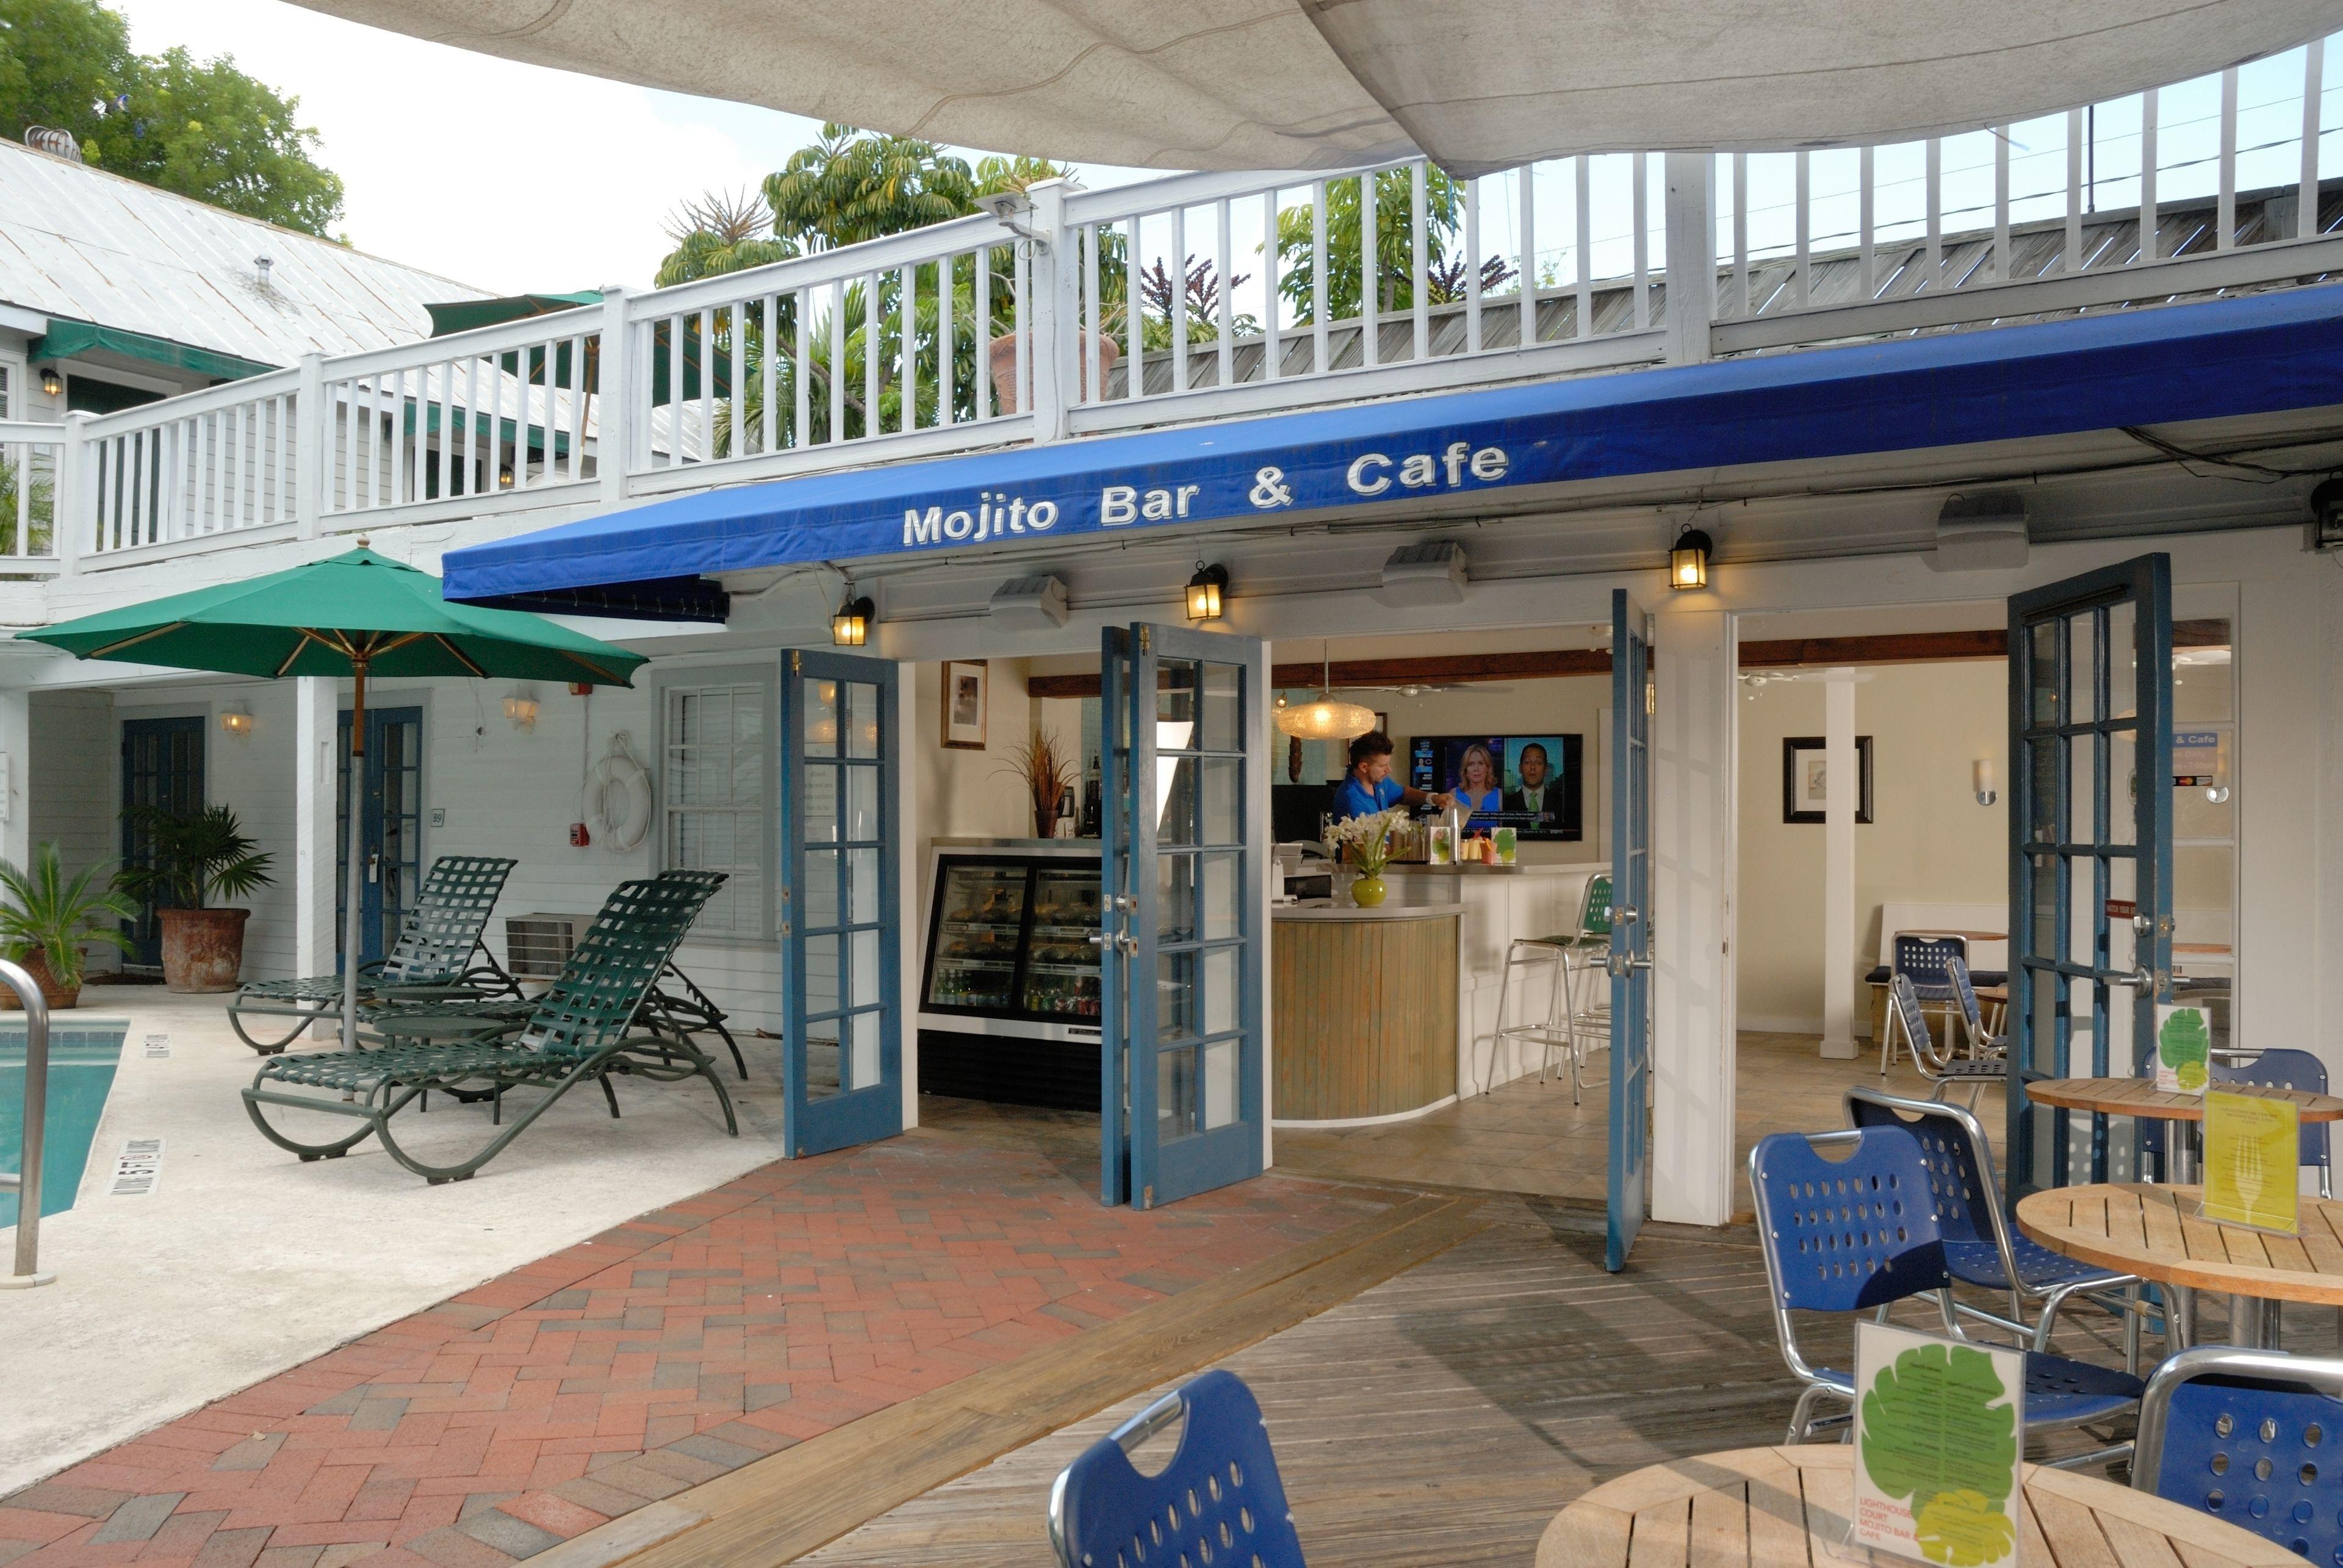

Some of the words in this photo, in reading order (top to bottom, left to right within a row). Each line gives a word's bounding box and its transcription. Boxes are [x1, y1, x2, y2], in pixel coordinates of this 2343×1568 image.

[903, 491, 1059, 547] Mojito
[1101, 484, 1200, 527] Bar
[1248, 466, 1294, 508] &
[1346, 441, 1510, 497] Cafe
[433, 813, 442, 822] B9
[1860, 1497, 1912, 1518] LIGHTHOUSE
[1860, 1508, 1888, 1522] COURT
[1860, 1518, 1891, 1534] MOJITO
[1893, 1528, 1910, 1539] BAR
[1860, 1528, 1881, 1541] CAFE
